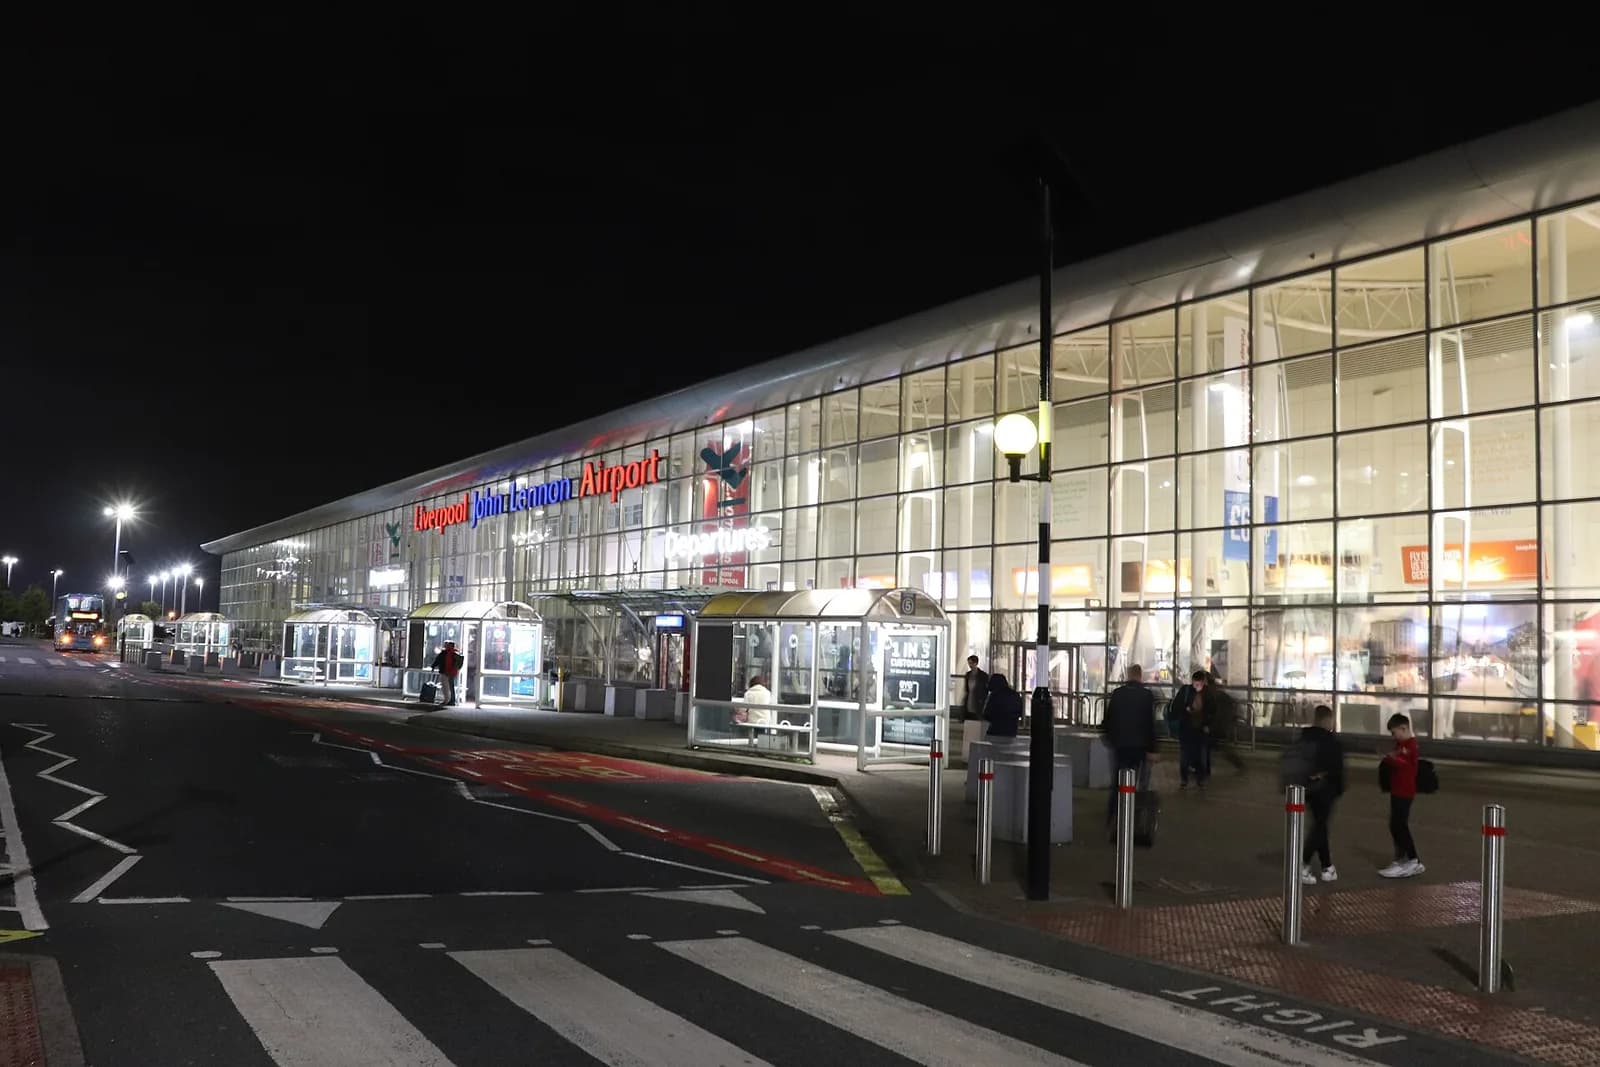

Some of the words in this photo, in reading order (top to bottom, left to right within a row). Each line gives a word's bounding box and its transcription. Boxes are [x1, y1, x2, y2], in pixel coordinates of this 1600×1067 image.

[413, 492, 469, 534] Liverpool
[470, 490, 504, 528] John
[509, 476, 572, 511] Lennon
[579, 448, 662, 503] Airport
[664, 523, 771, 564] Departures
[708, 576, 740, 586] LIVRPOOL
[905, 600, 911, 612] 5
[892, 641, 900, 658] 1
[903, 641, 919, 659] IN
[890, 658, 931, 669] CUSTOMERS
[1160, 986, 1408, 1050] RIGHT
